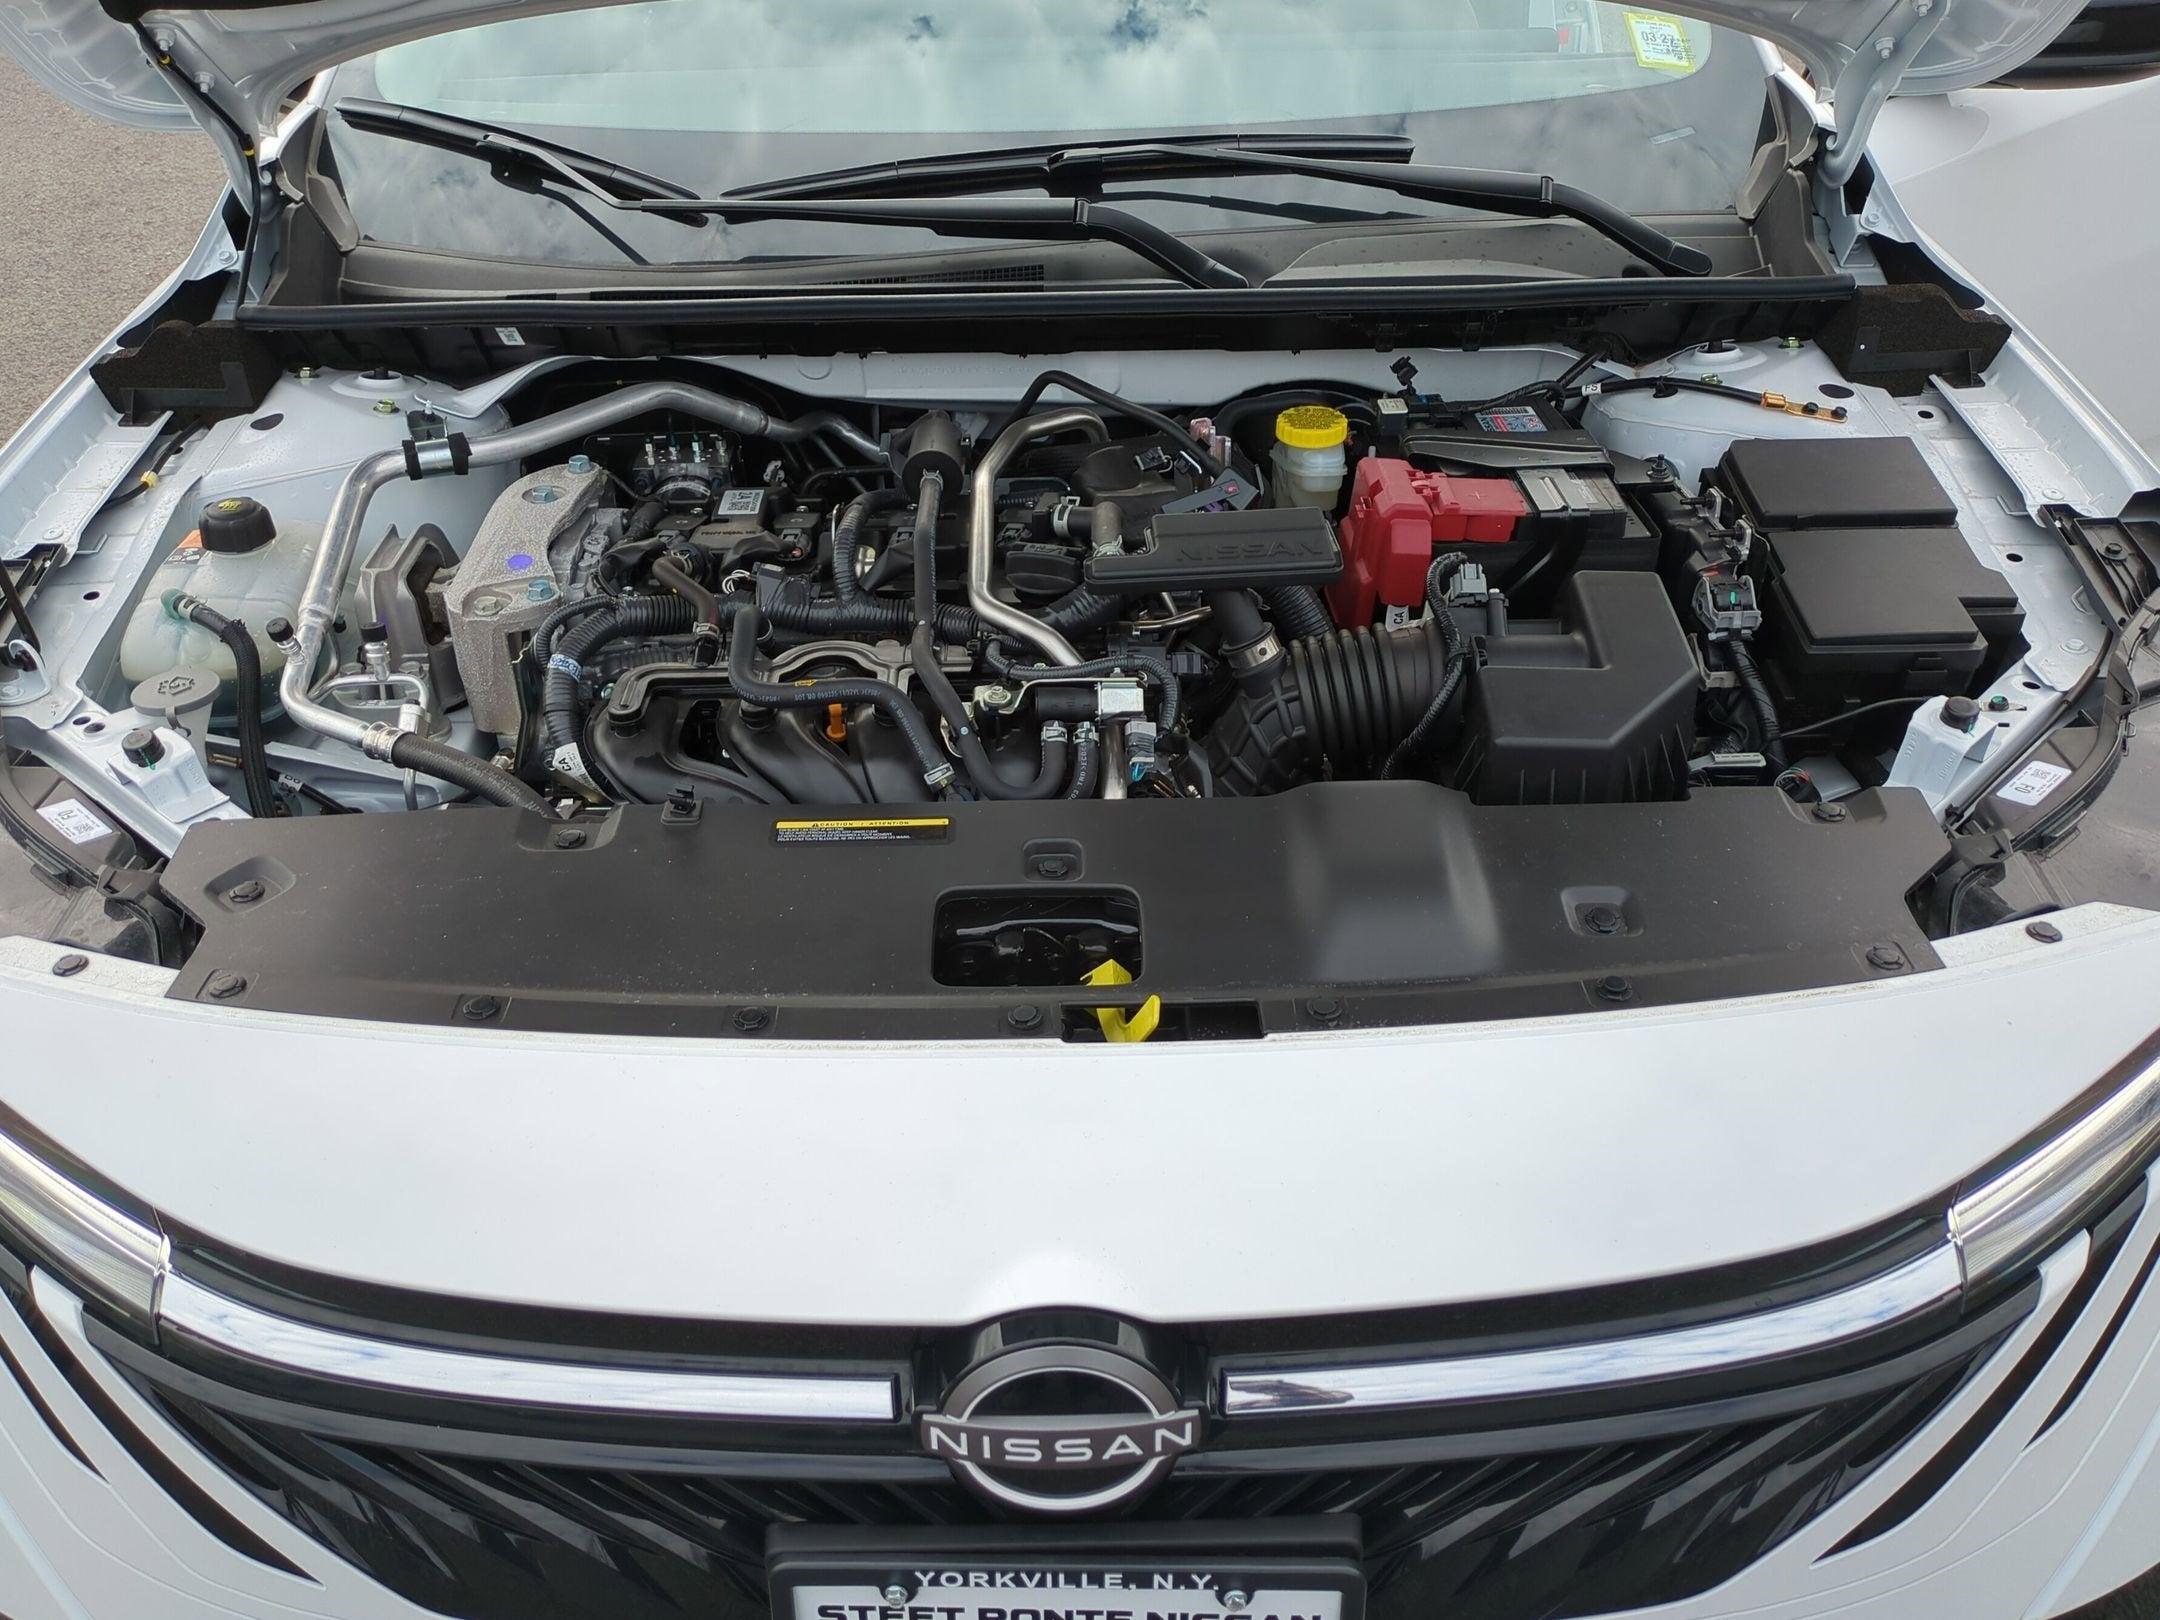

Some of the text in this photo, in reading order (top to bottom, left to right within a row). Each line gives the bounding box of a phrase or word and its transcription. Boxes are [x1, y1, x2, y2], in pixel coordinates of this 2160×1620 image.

[1641, 31, 1657, 42] 03
[1176, 542, 1323, 562] NISSAN
[1393, 611, 1405, 625] CA
[558, 757, 573, 772] CA
[930, 1422, 1192, 1462] NISSAN
[914, 1571, 1219, 1592] YORKVILLE, N.Y.
[817, 1605, 965, 1620] STEET
